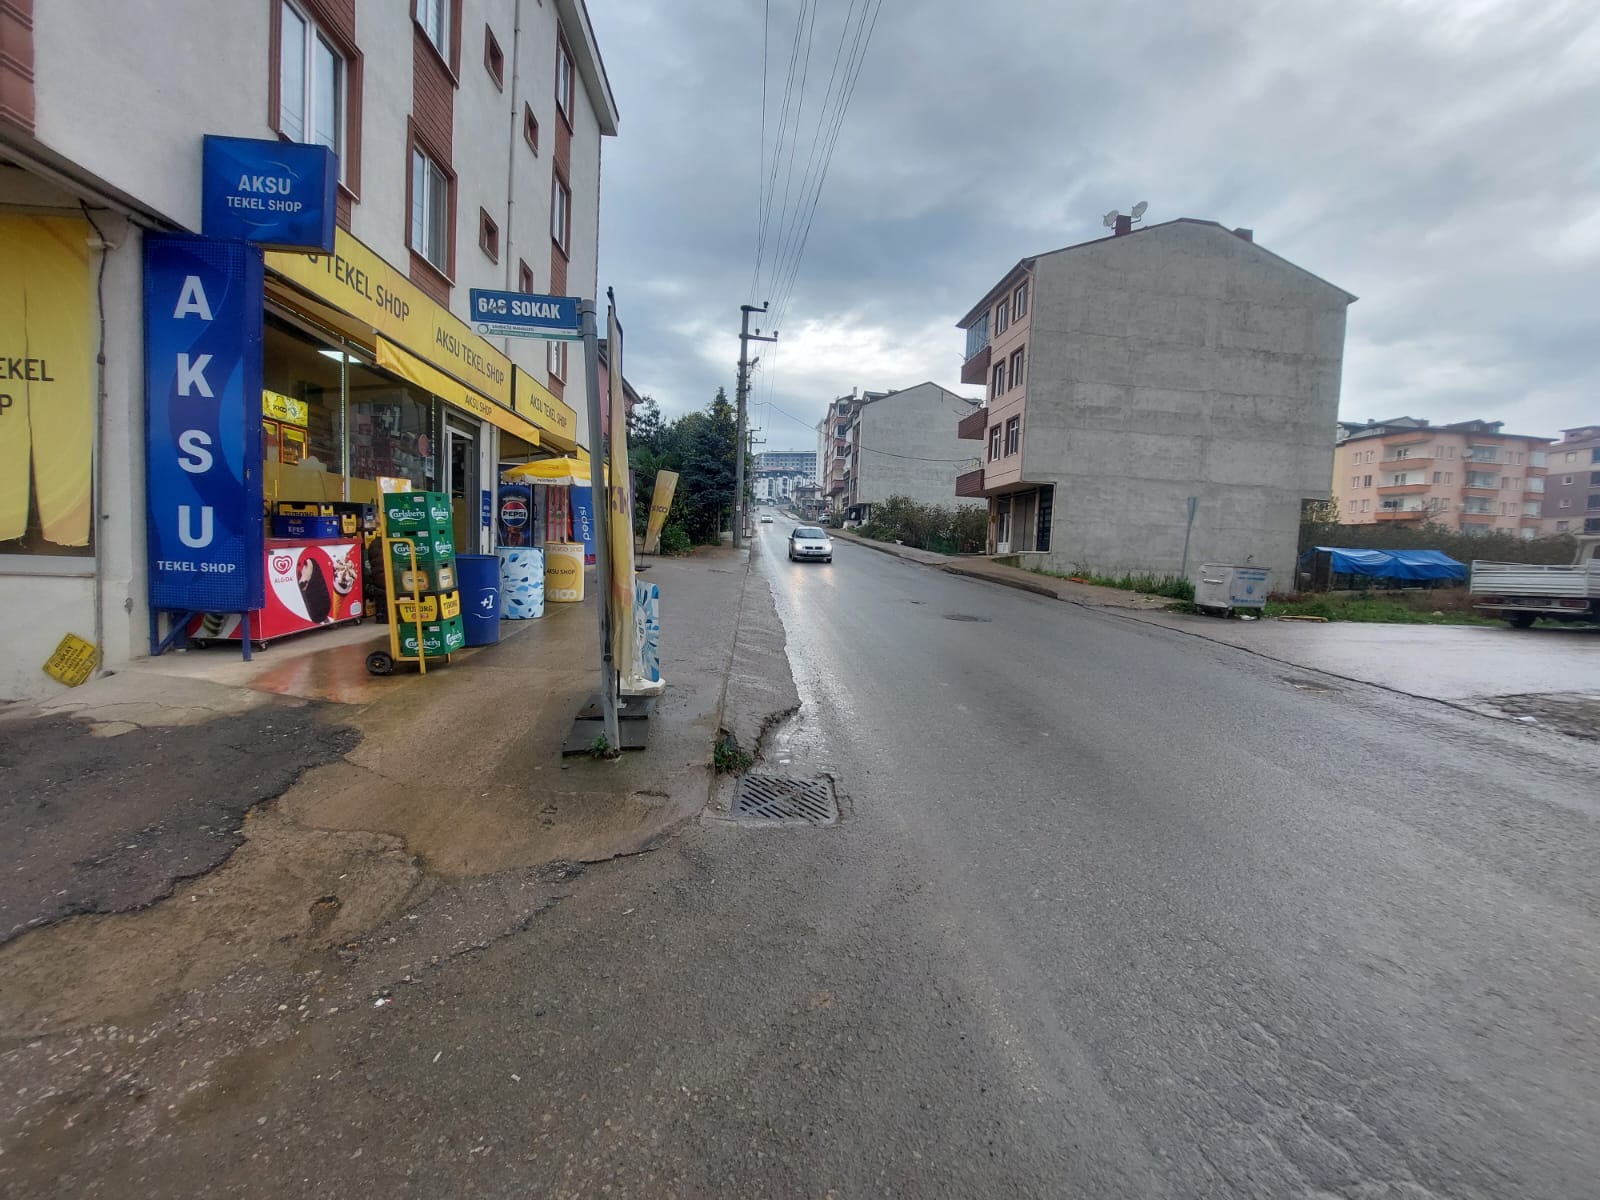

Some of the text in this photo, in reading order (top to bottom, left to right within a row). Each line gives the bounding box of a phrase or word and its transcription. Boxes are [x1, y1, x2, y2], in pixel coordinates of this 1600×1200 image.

[238, 174, 291, 195] AKSU
[226, 196, 302, 213] TEKEL SHOP
[376, 284, 410, 322] SHOP
[511, 301, 561, 319] SOKAK
[436, 327, 504, 386] AKSU TEKEL SHOP
[479, 401, 492, 417] SHOP
[389, 508, 425, 521] Carlsberg
[578, 506, 591, 541] pepsi
[157, 560, 236, 573] TEKEL SHOP
[480, 595, 494, 609] +1
